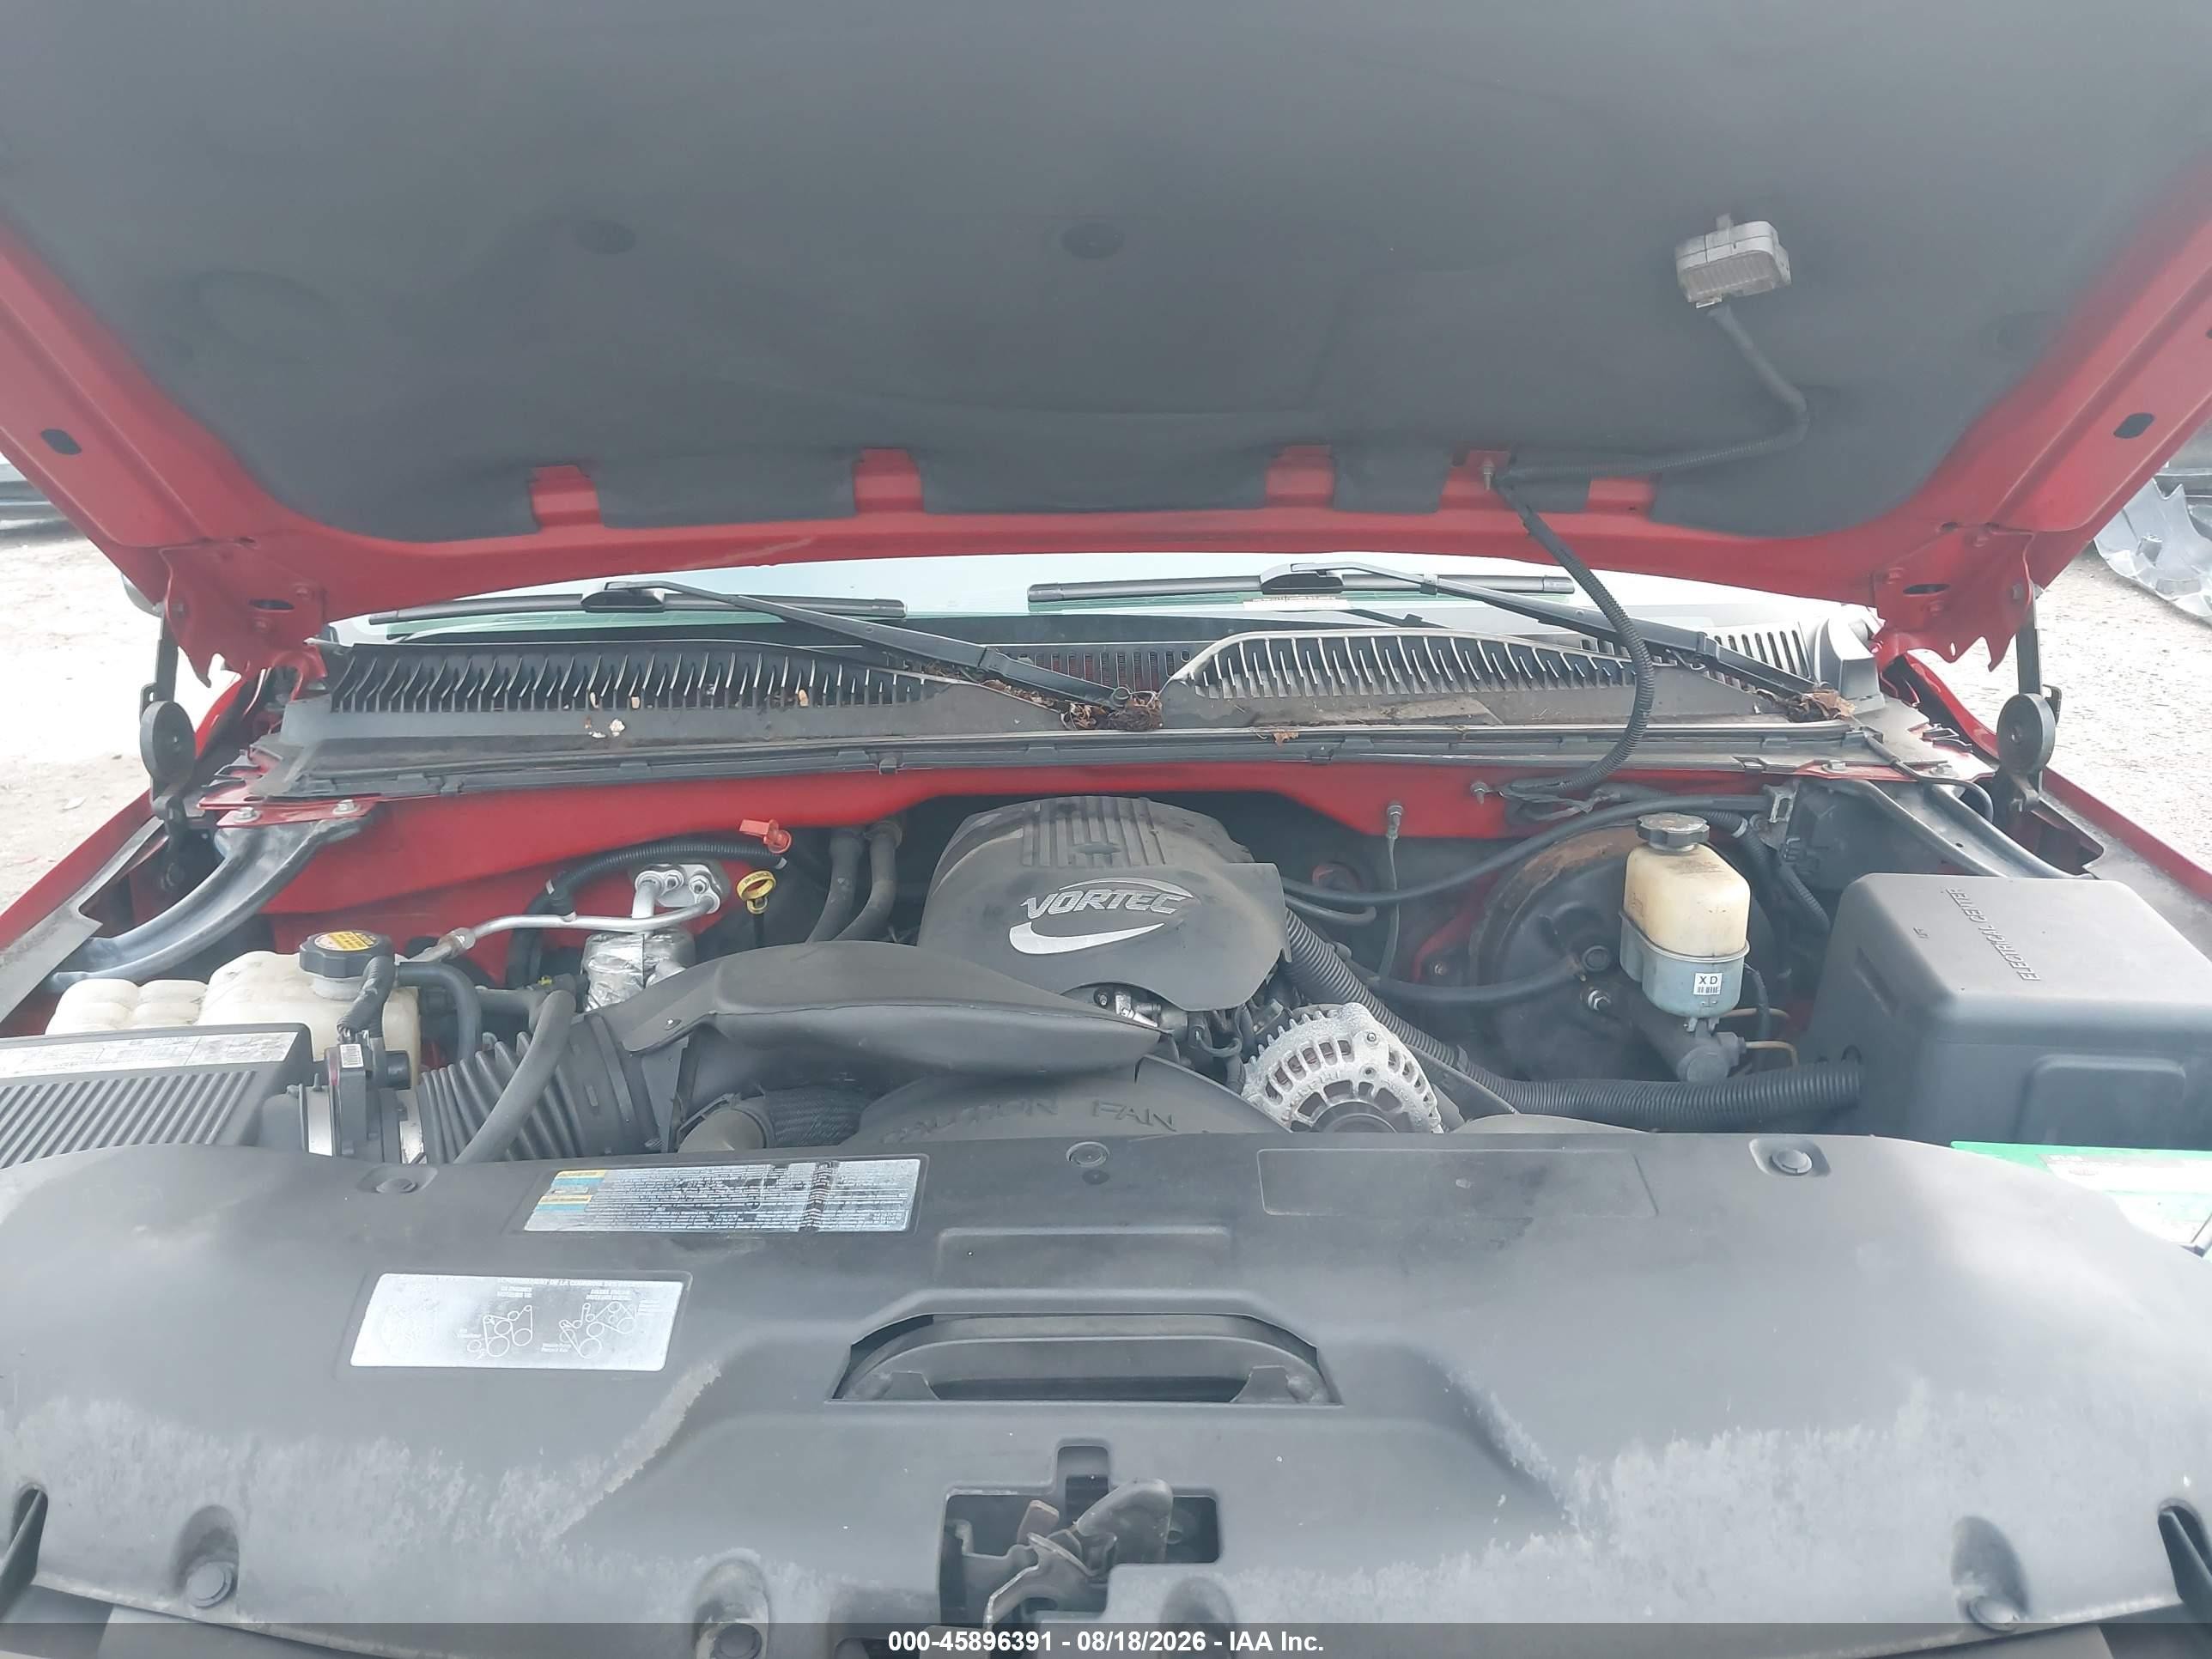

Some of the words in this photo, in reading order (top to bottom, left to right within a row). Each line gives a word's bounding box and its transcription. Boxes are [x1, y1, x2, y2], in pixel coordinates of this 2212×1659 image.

[1019, 888, 1188, 920] VORTEC
[1945, 887, 1988, 923] CENTER
[1978, 925, 2042, 981] ELECTRICAL
[1091, 1100, 1178, 1133] FAN
